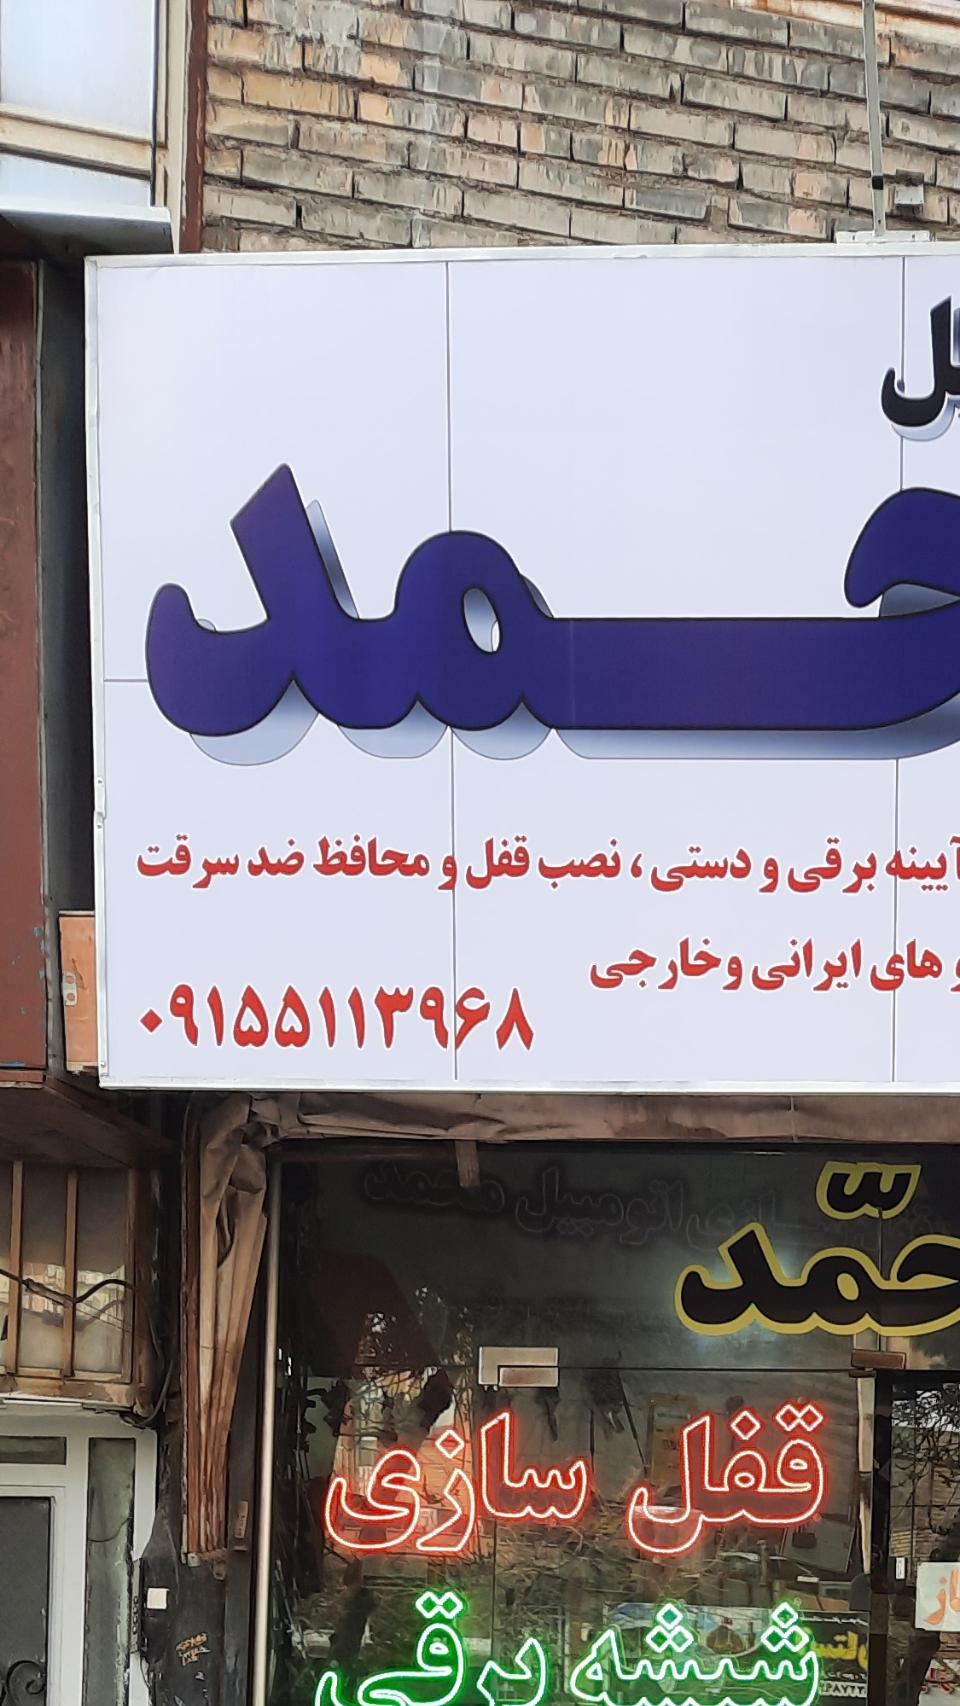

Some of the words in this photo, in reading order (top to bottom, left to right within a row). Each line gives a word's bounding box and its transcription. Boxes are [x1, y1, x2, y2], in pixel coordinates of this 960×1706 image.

[136, 834, 240, 890] سرقت
[246, 839, 306, 878] ضد
[313, 835, 431, 878] محافظ
[439, 854, 459, 892] و
[465, 835, 531, 891] قفل
[537, 839, 622, 889] نصب
[760, 857, 780, 894] و
[786, 836, 878, 895] برقی
[751, 938, 863, 993] ایرانی
[869, 939, 944, 993] های
[140, 983, 535, 1050] ۰۹۱۵۵۱۱۳۹۶۸
[323, 1410, 590, 1552] سازی
[628, 1402, 825, 1554] قفل
